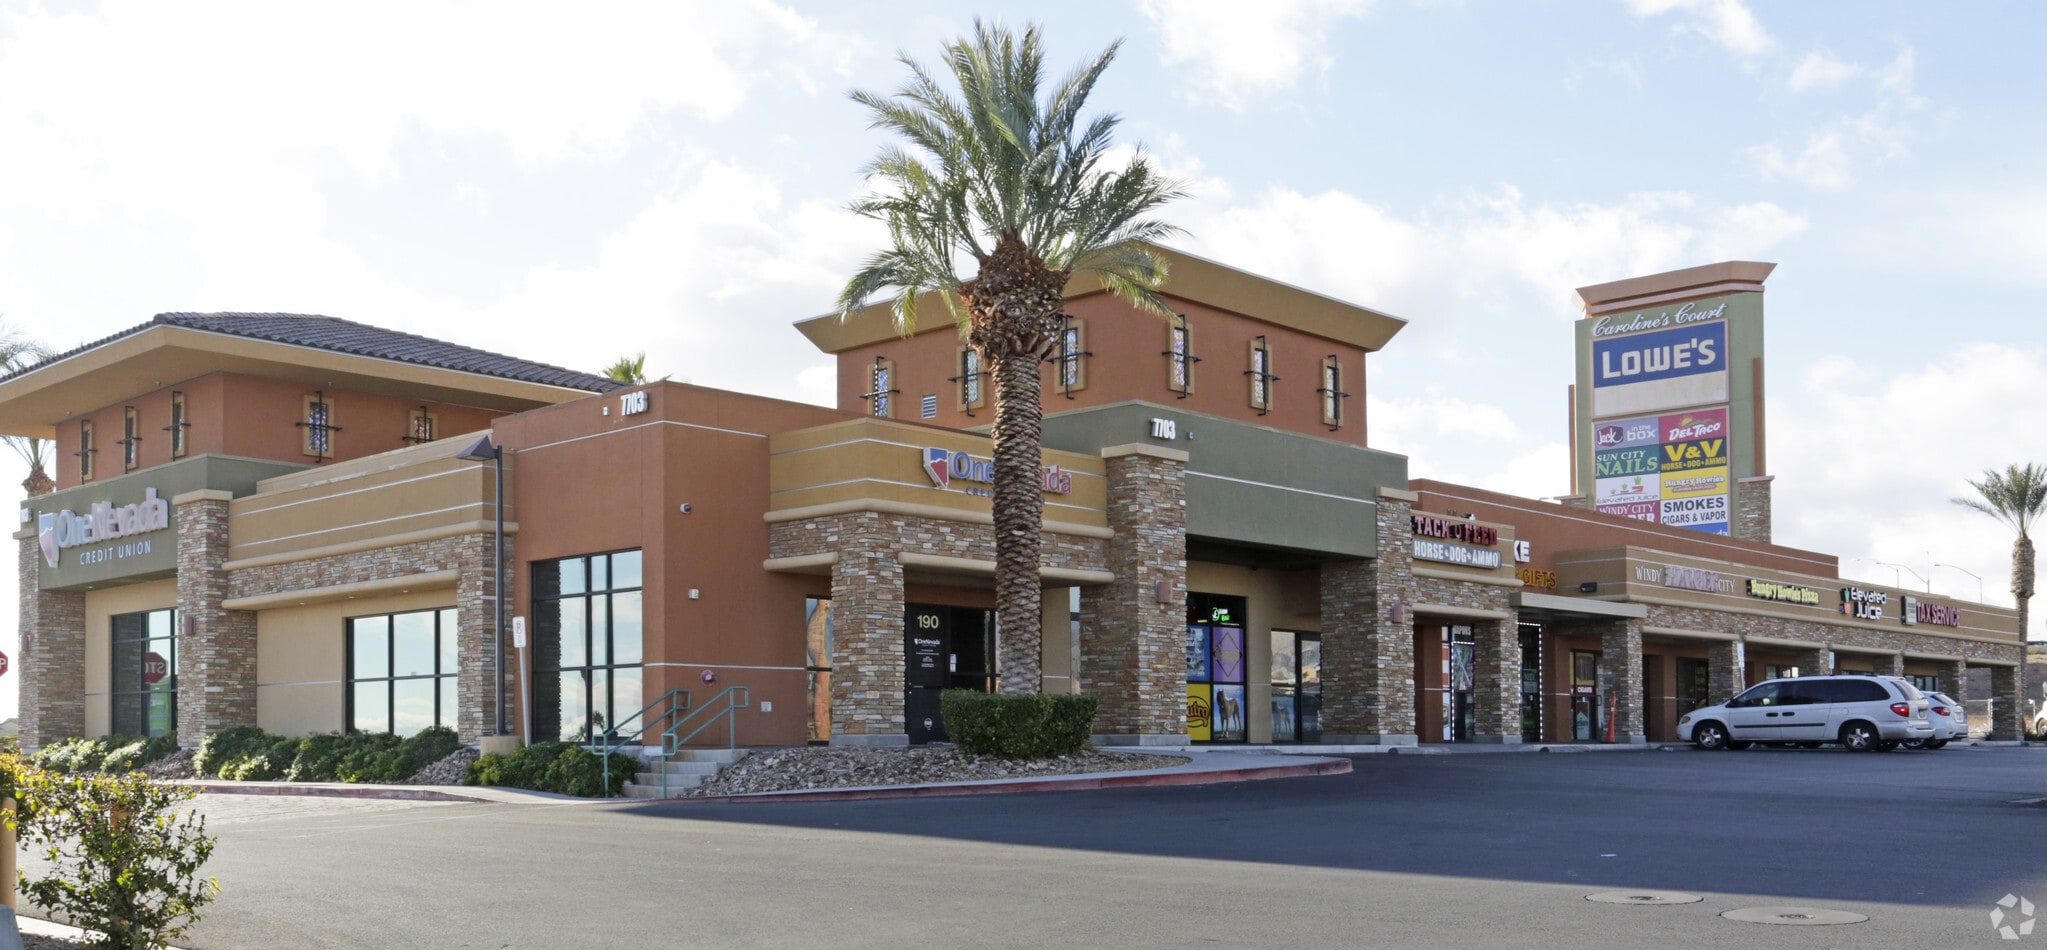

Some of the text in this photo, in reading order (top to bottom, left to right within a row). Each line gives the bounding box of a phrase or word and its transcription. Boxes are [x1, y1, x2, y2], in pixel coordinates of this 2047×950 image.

[1593, 302, 1727, 337] Caroline's Court
[1602, 338, 1716, 379] LOWE'S
[620, 390, 646, 416] 7703
[1152, 417, 1176, 440] 7703
[1597, 427, 1623, 445] Jack
[1627, 428, 1656, 441] box
[1669, 428, 1693, 441] DEL
[1596, 456, 1658, 477] NAILS
[1597, 450, 1646, 463] SUN CITY
[1661, 457, 1727, 471] HORSE DOG AMMO
[953, 451, 1071, 493] Oneada
[965, 486, 993, 498] CRED
[1631, 502, 1655, 513] CITY
[1664, 497, 1724, 513] SMOKES
[1414, 516, 1450, 538] TACK
[1662, 511, 1726, 525] CIGARS & VAPOR
[79, 540, 151, 566] CREDIT UNION
[1413, 540, 1499, 567] HORSE DOG AMMO
[1522, 568, 1556, 589] GIFTS
[1635, 566, 1662, 583] WINDY
[1718, 578, 1736, 592] CITY
[1856, 601, 1882, 620] Juice
[1916, 602, 1931, 624] TAX
[1931, 605, 1960, 627] SERVICE
[917, 615, 939, 629] 190
